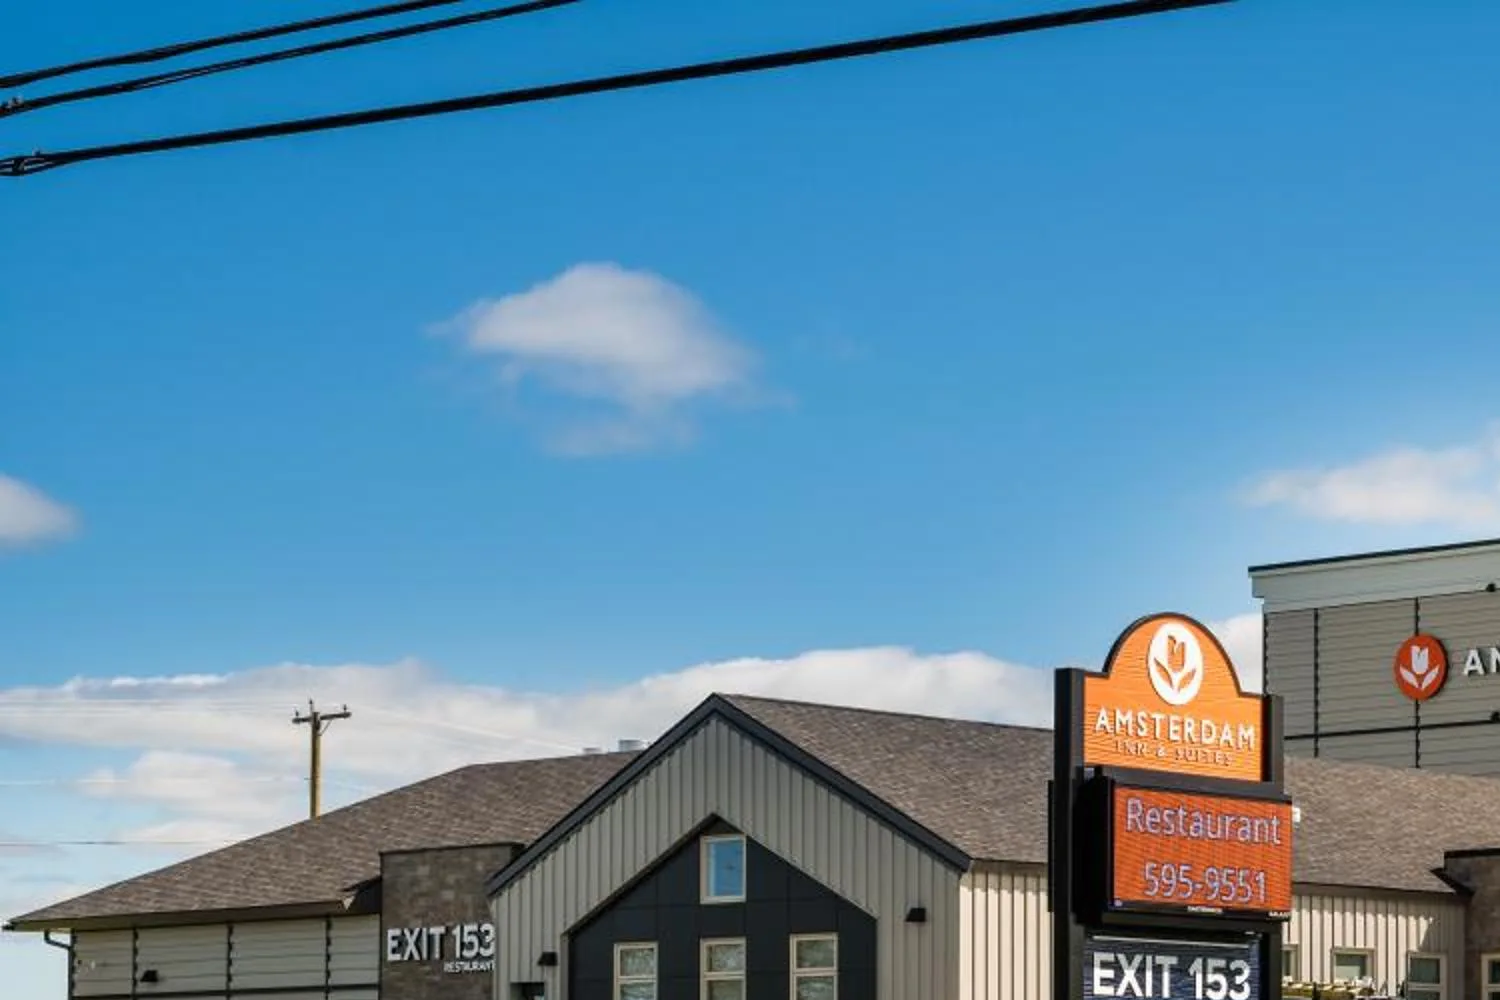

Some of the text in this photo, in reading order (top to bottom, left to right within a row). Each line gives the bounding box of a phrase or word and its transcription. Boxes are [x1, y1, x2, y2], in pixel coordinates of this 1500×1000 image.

[1095, 706, 1255, 750] AMSTERDAM
[1125, 797, 1281, 845] Restaurant
[1143, 861, 1266, 903] 595-9551
[387, 922, 496, 961] EXIT 153
[1092, 951, 1179, 999] EXIT
